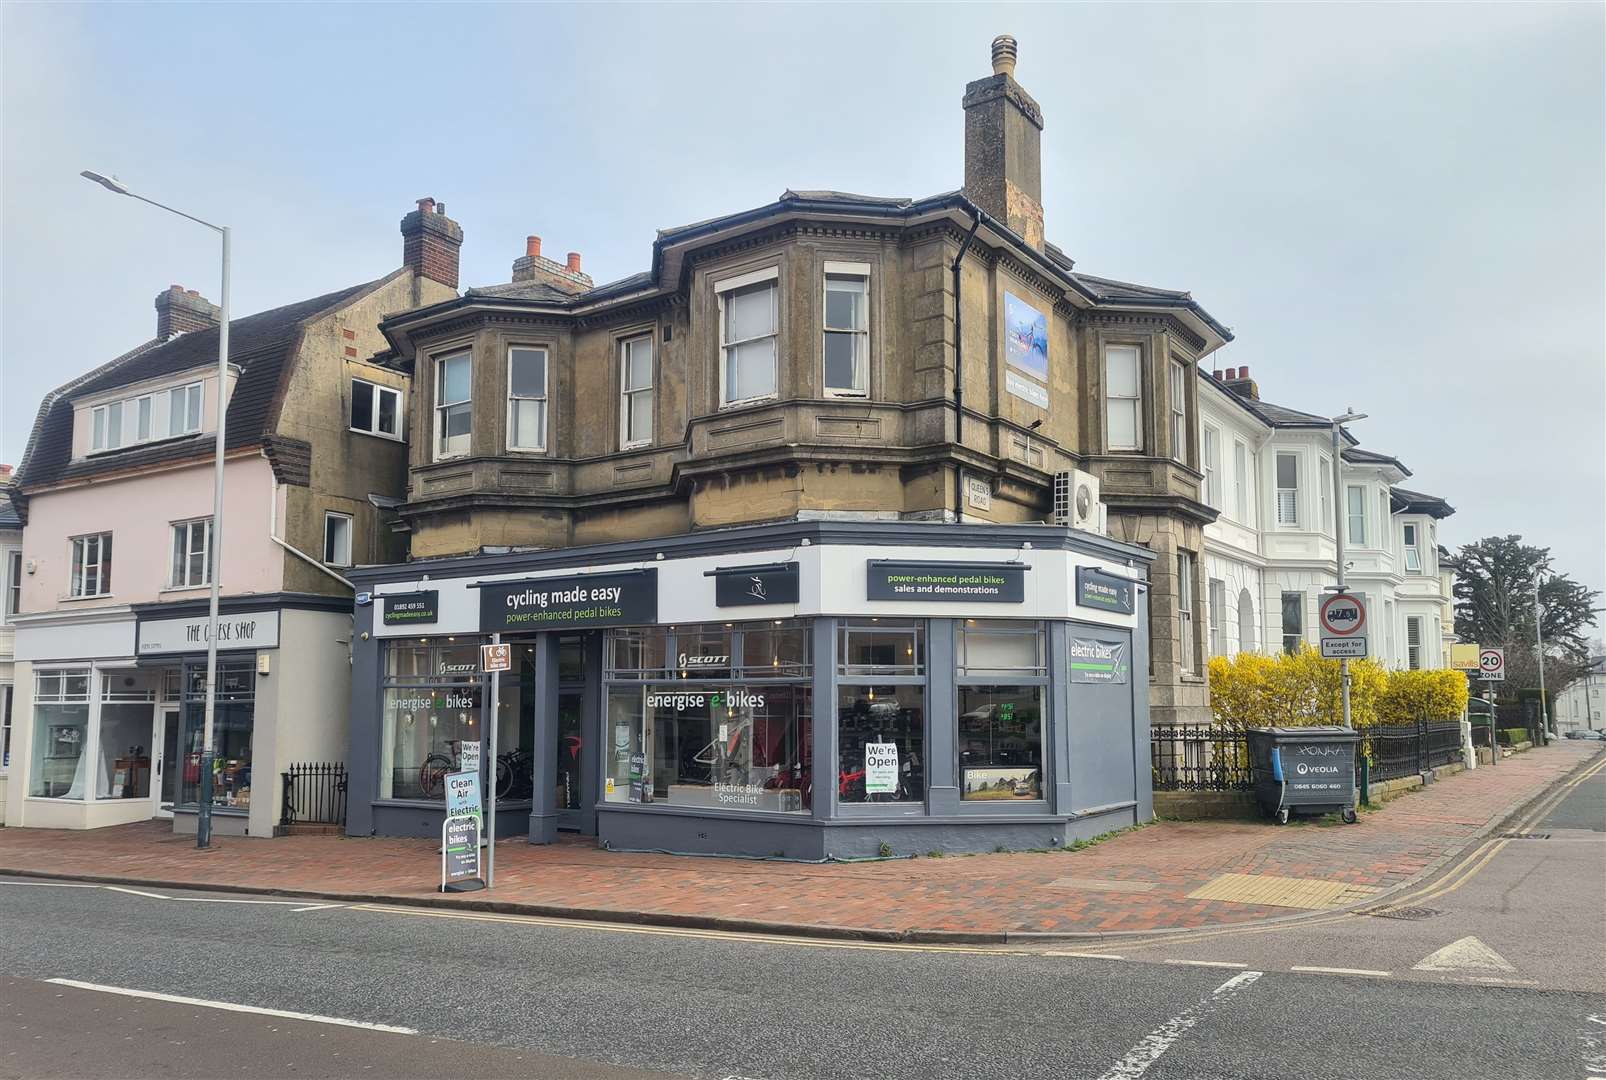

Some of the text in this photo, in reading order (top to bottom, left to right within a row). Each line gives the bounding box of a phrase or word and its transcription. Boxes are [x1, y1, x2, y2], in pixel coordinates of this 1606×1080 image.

[974, 494, 986, 506] ROAD
[888, 574, 1005, 585] power-enhanced pedal bikes
[894, 584, 999, 594] sales and demonstrations
[506, 585, 621, 610] cycling made easy
[506, 606, 622, 624] power-enhanced pedal bikes
[186, 620, 257, 642] THE CESE SHOP
[1071, 642, 1112, 659] electric bikes
[688, 656, 730, 664] SCOTT
[1482, 656, 1499, 666] 20
[446, 663, 477, 672] SCOTT
[390, 696, 431, 712] energise
[647, 692, 704, 711] energise
[462, 743, 479, 751] We're
[868, 745, 896, 755] We're
[462, 751, 479, 762] Open
[868, 756, 897, 769] Open
[967, 770, 988, 779] Bike
[1308, 766, 1339, 774] VEOLIA
[451, 779, 473, 789] Clean
[714, 782, 764, 795] Electric Bike
[457, 789, 468, 799] Air
[719, 792, 758, 805] Specialist
[450, 804, 479, 817] Electric
[448, 822, 475, 833] electric
[448, 834, 468, 845] bikes
